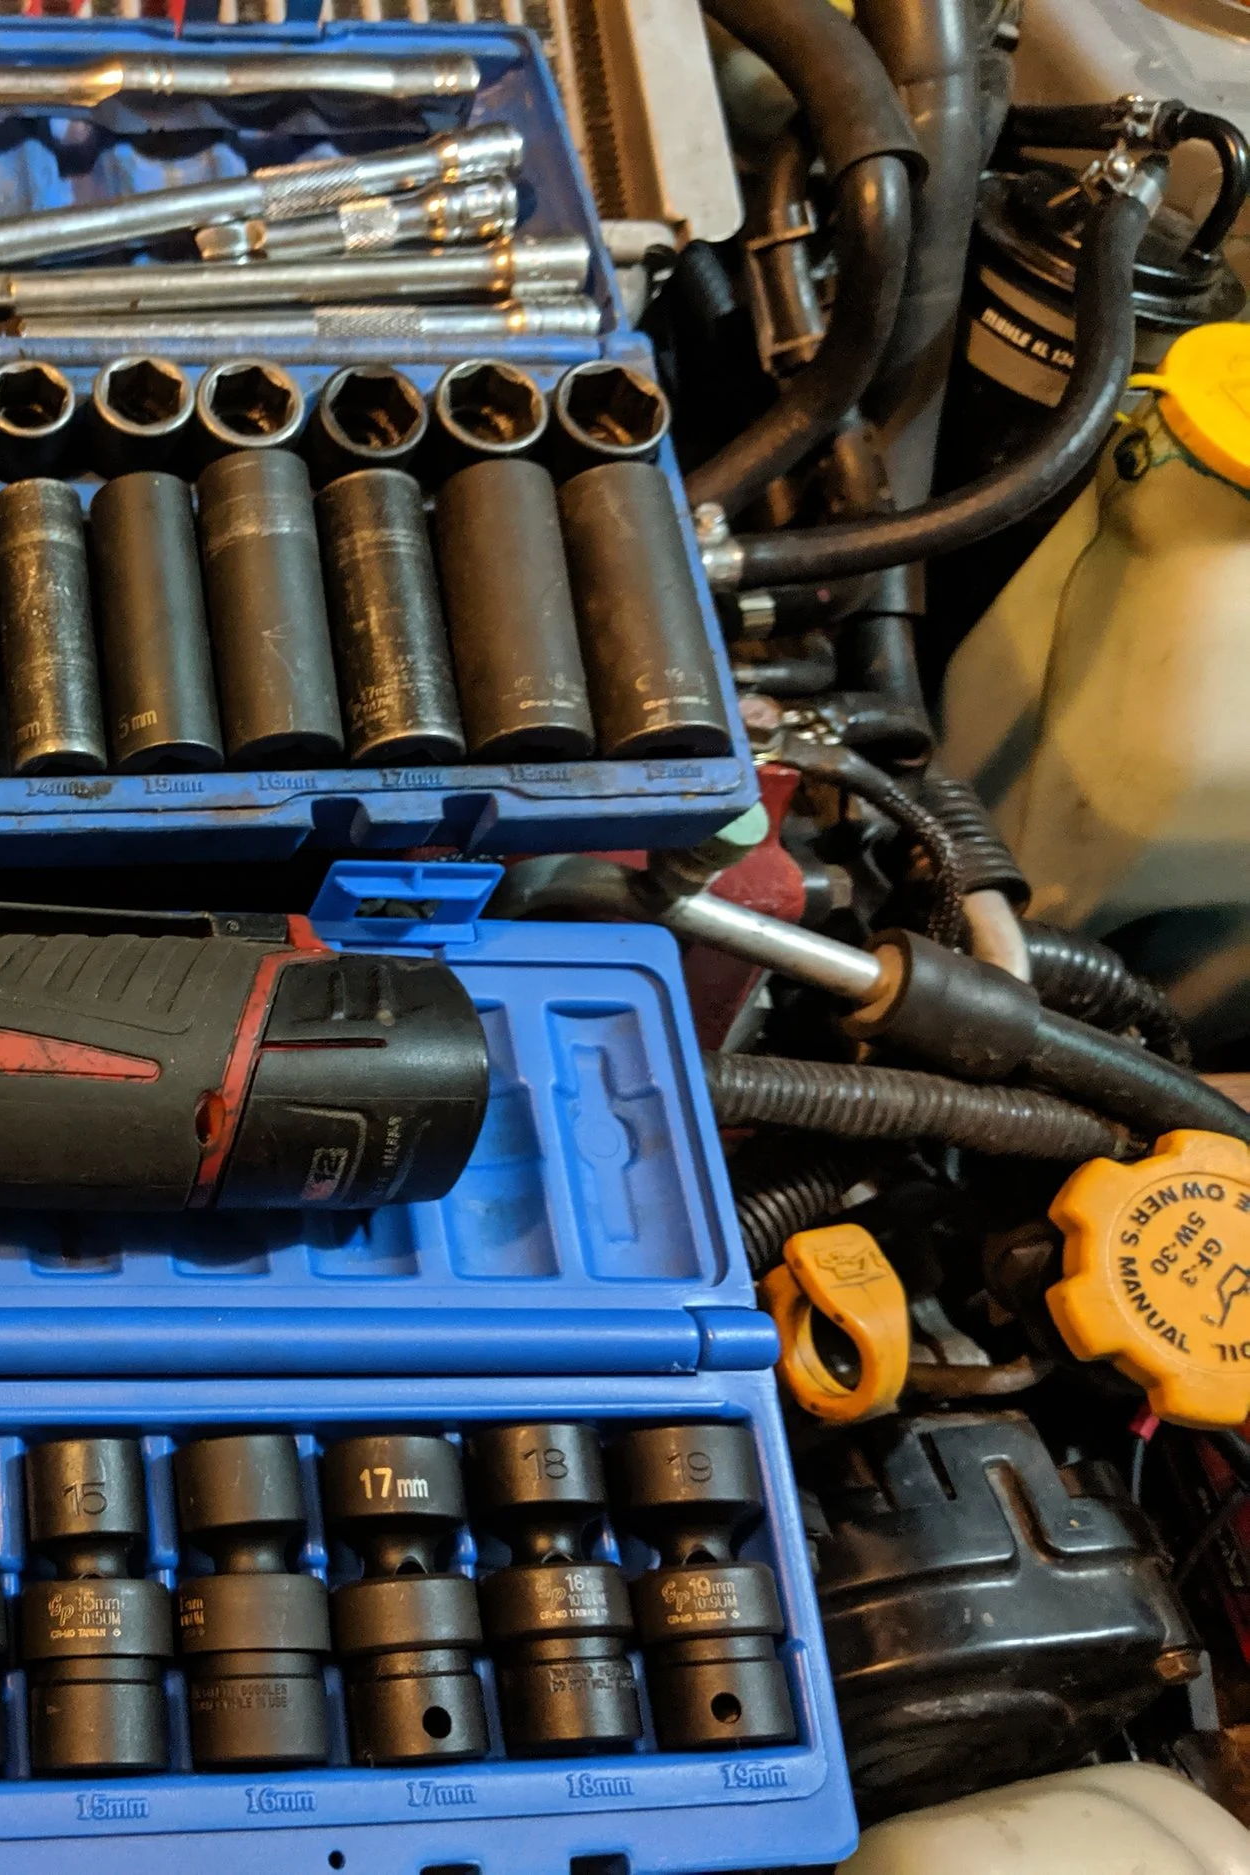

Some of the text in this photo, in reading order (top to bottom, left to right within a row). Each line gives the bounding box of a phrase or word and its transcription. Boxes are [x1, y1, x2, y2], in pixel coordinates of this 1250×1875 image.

[144, 777, 204, 794] 15mm
[1120, 1181, 1225, 1249] OWNER'S
[1150, 1211, 1206, 1275] 5W-30
[1179, 1237, 1222, 1287] GF-3
[1119, 1255, 1190, 1354] MANUAL
[522, 1448, 570, 1480] 18
[666, 1451, 713, 1484] 19
[62, 1482, 108, 1517] 15
[689, 1577, 735, 1597] 19mm
[565, 1773, 635, 1798] 18mm
[719, 1762, 788, 1789] 19mm
[77, 1793, 149, 1820] 15mm
[245, 1787, 317, 1813] 16mm
[405, 1780, 476, 1807] 17mm
